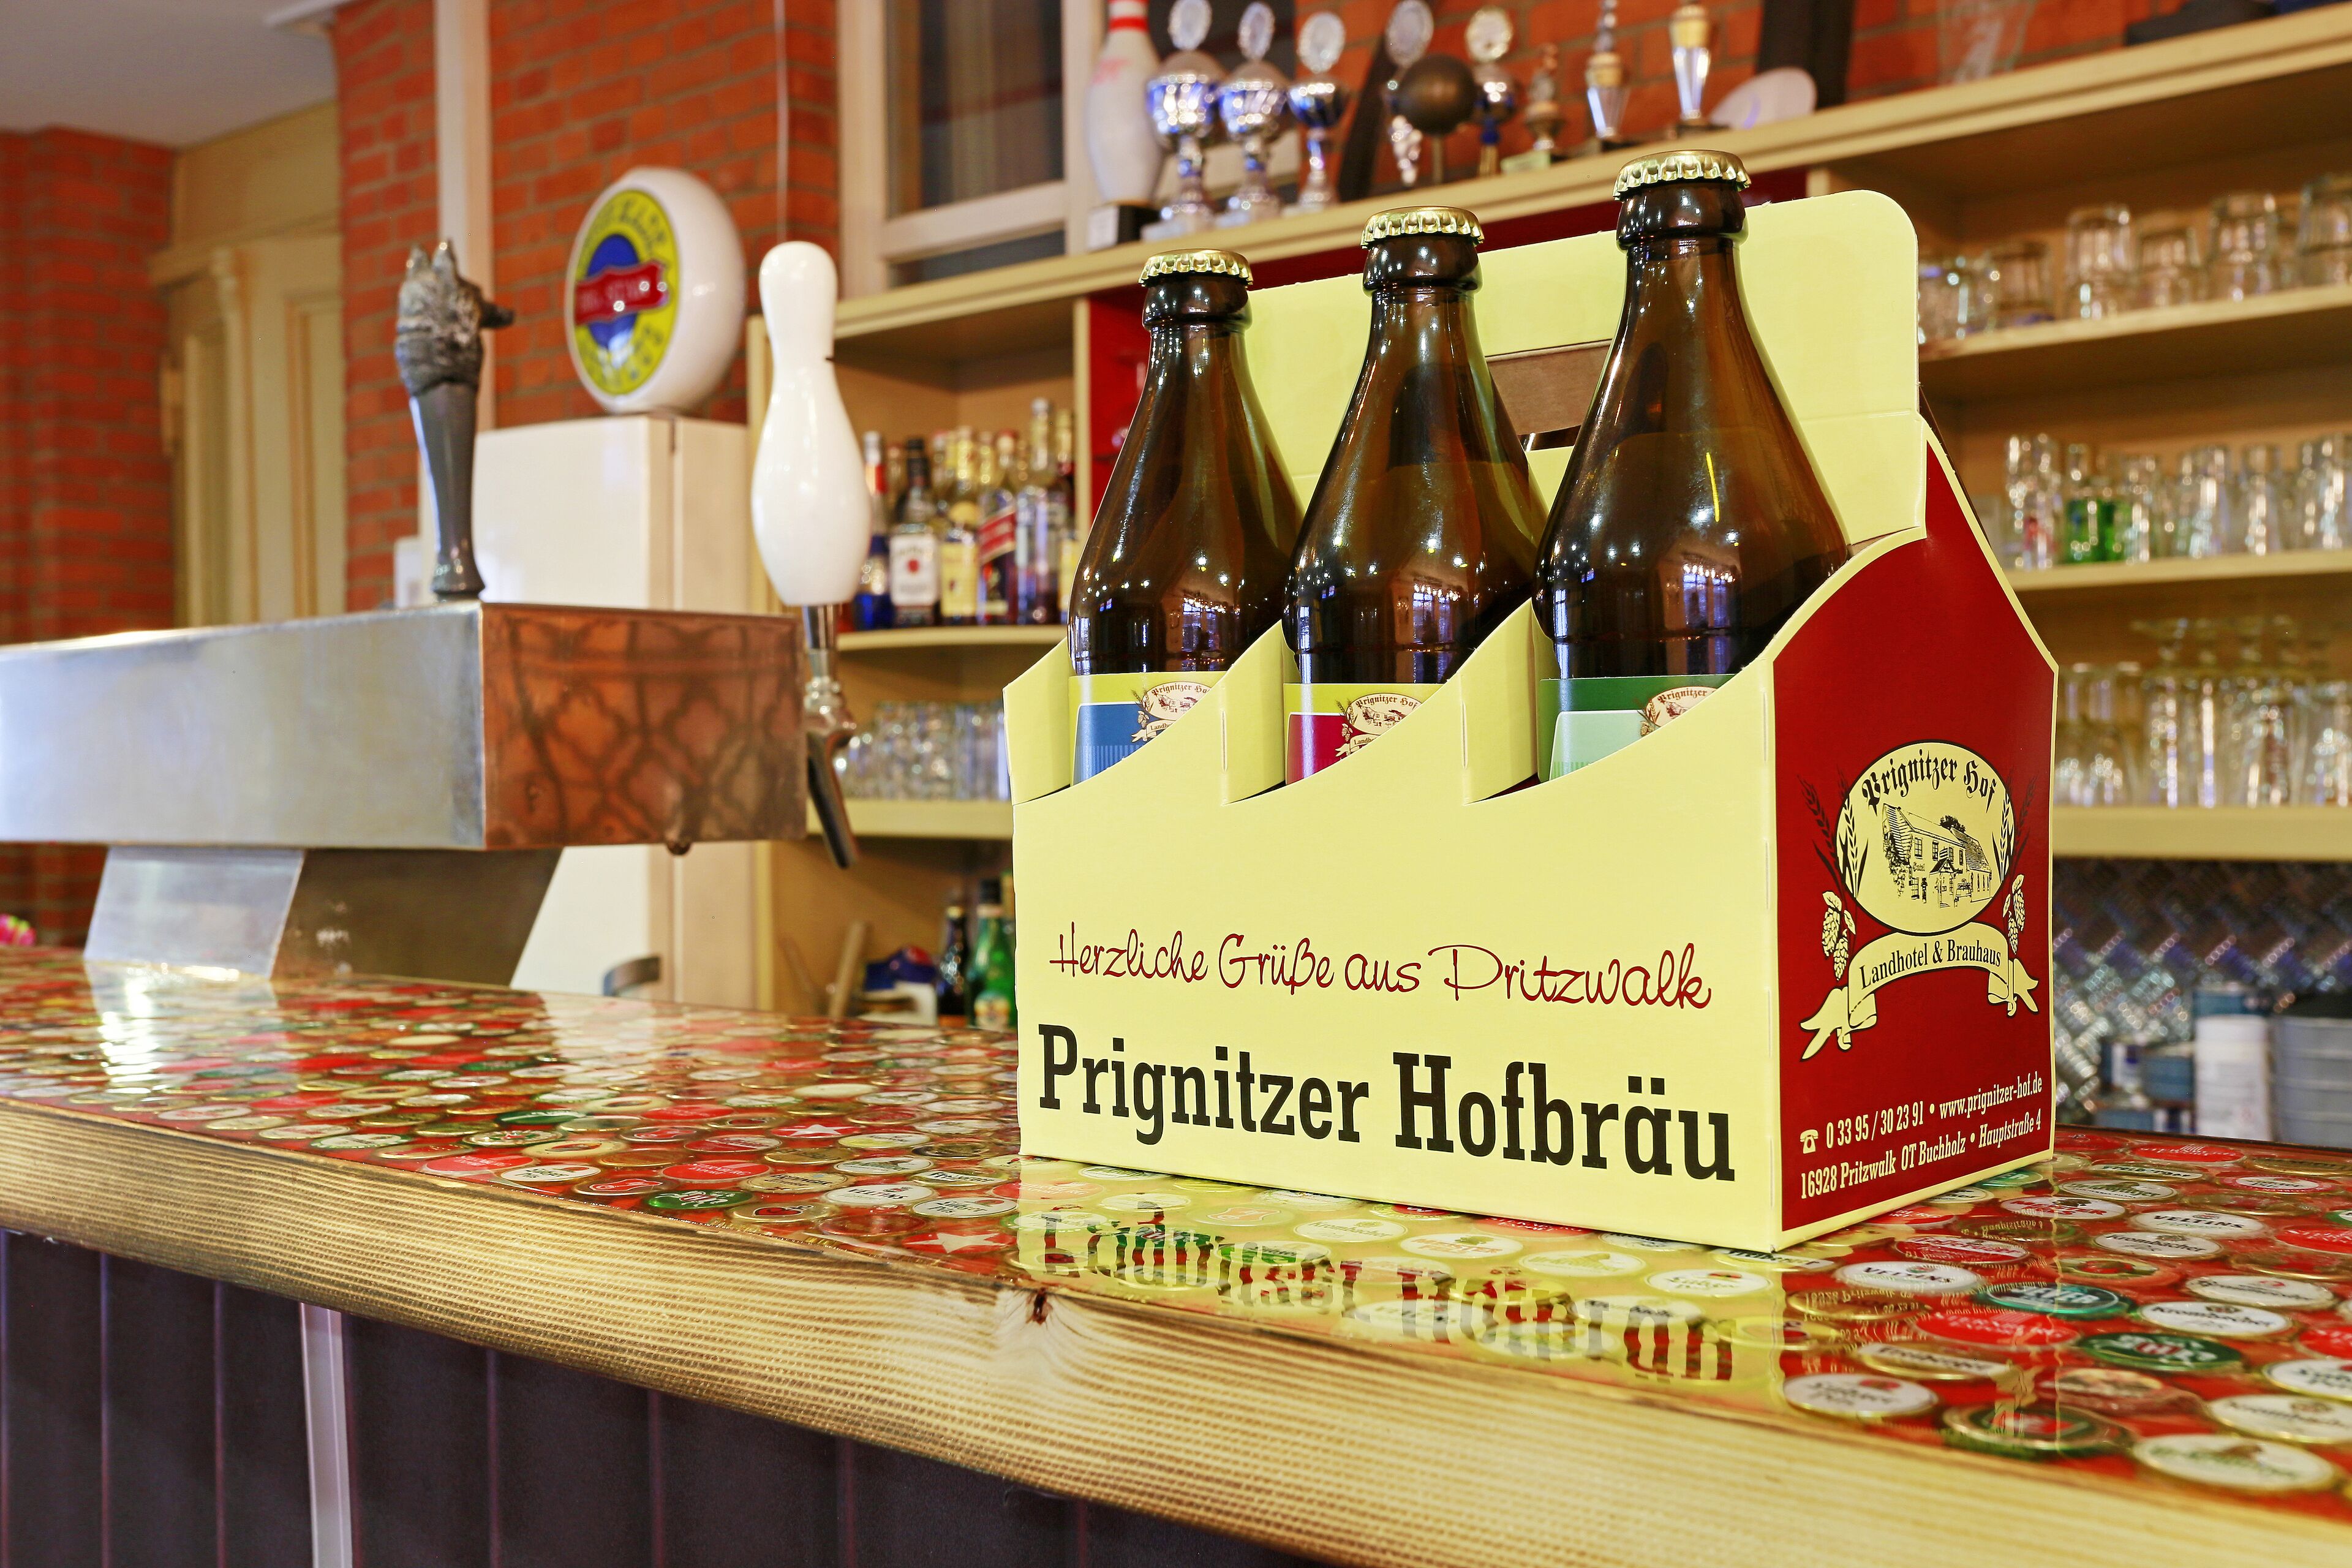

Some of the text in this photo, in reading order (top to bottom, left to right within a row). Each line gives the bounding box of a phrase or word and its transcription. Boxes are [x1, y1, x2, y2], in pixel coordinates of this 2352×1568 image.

[1152, 683, 1210, 697] Prignitzer Ho
[1657, 688, 1708, 704] Prignitzer
[1355, 695, 1418, 710] Prignitzer Hof
[1862, 748, 1997, 816] Prignitzer Hof
[1050, 921, 1712, 1009] Herzliche Grüße aus Pritzwalk
[1858, 939, 2002, 990] Landhotel & Brauhaus
[1038, 1023, 1735, 1182] Prignitzer Hofbräu
[1826, 1122, 1834, 1148] 0
[1837, 1118, 1852, 1146] 33
[1855, 1114, 1869, 1142] 95
[1880, 1107, 1893, 1136] 30
[1896, 1104, 1909, 1131] 23
[1912, 1101, 1923, 1127] 91
[1939, 1071, 2043, 1119] www.prignitzer-hof.de
[1801, 1109, 2041, 1199] 16928 Pritzwalk OT Buchholz Hauptstraße 4
[848, 1188, 909, 1200] VELTINS
[1308, 1221, 1393, 1237] Krombacher
[2154, 1215, 2245, 1228] VELTINS
[2105, 1234, 2206, 1252] Krombacher
